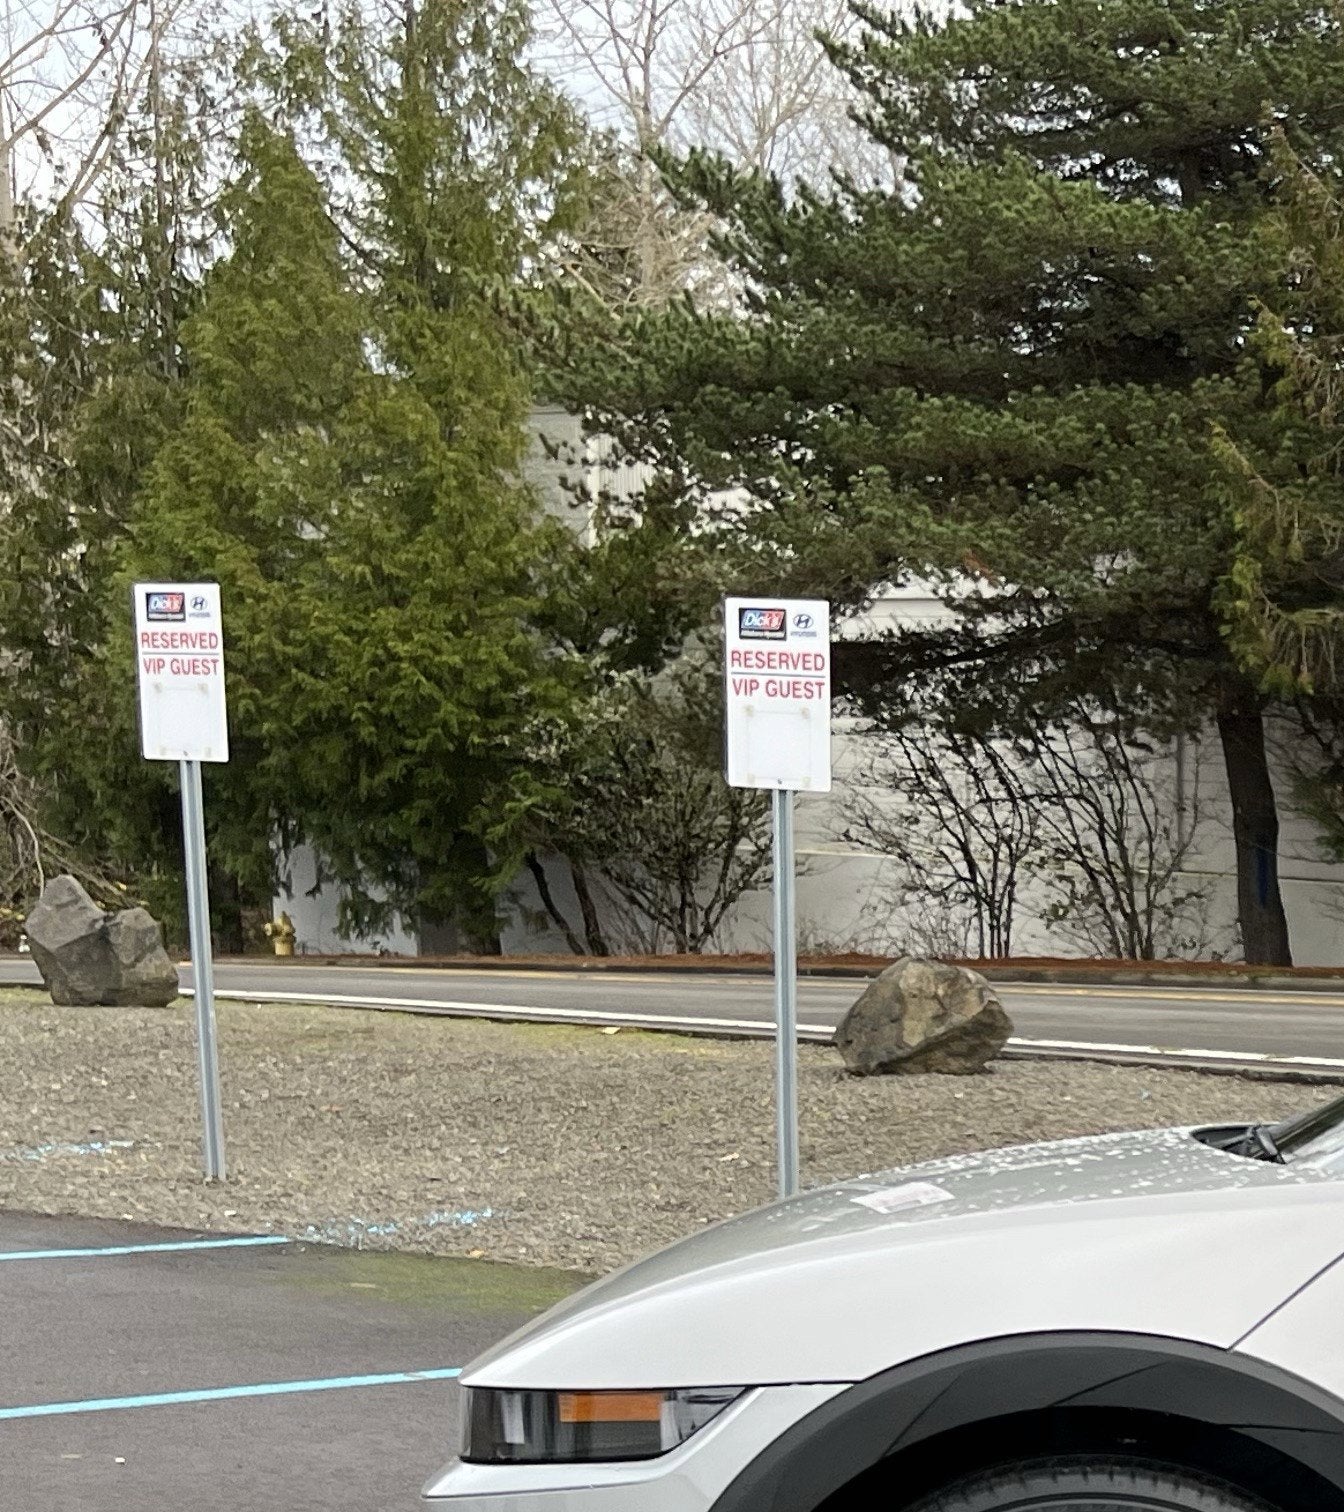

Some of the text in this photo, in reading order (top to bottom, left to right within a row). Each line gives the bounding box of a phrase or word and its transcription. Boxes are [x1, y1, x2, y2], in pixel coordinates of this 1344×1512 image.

[141, 632, 218, 649] RESERVED
[143, 658, 219, 675] VIP GUEST
[731, 650, 825, 672] RESERVED
[733, 678, 825, 699] VIP GUEST
